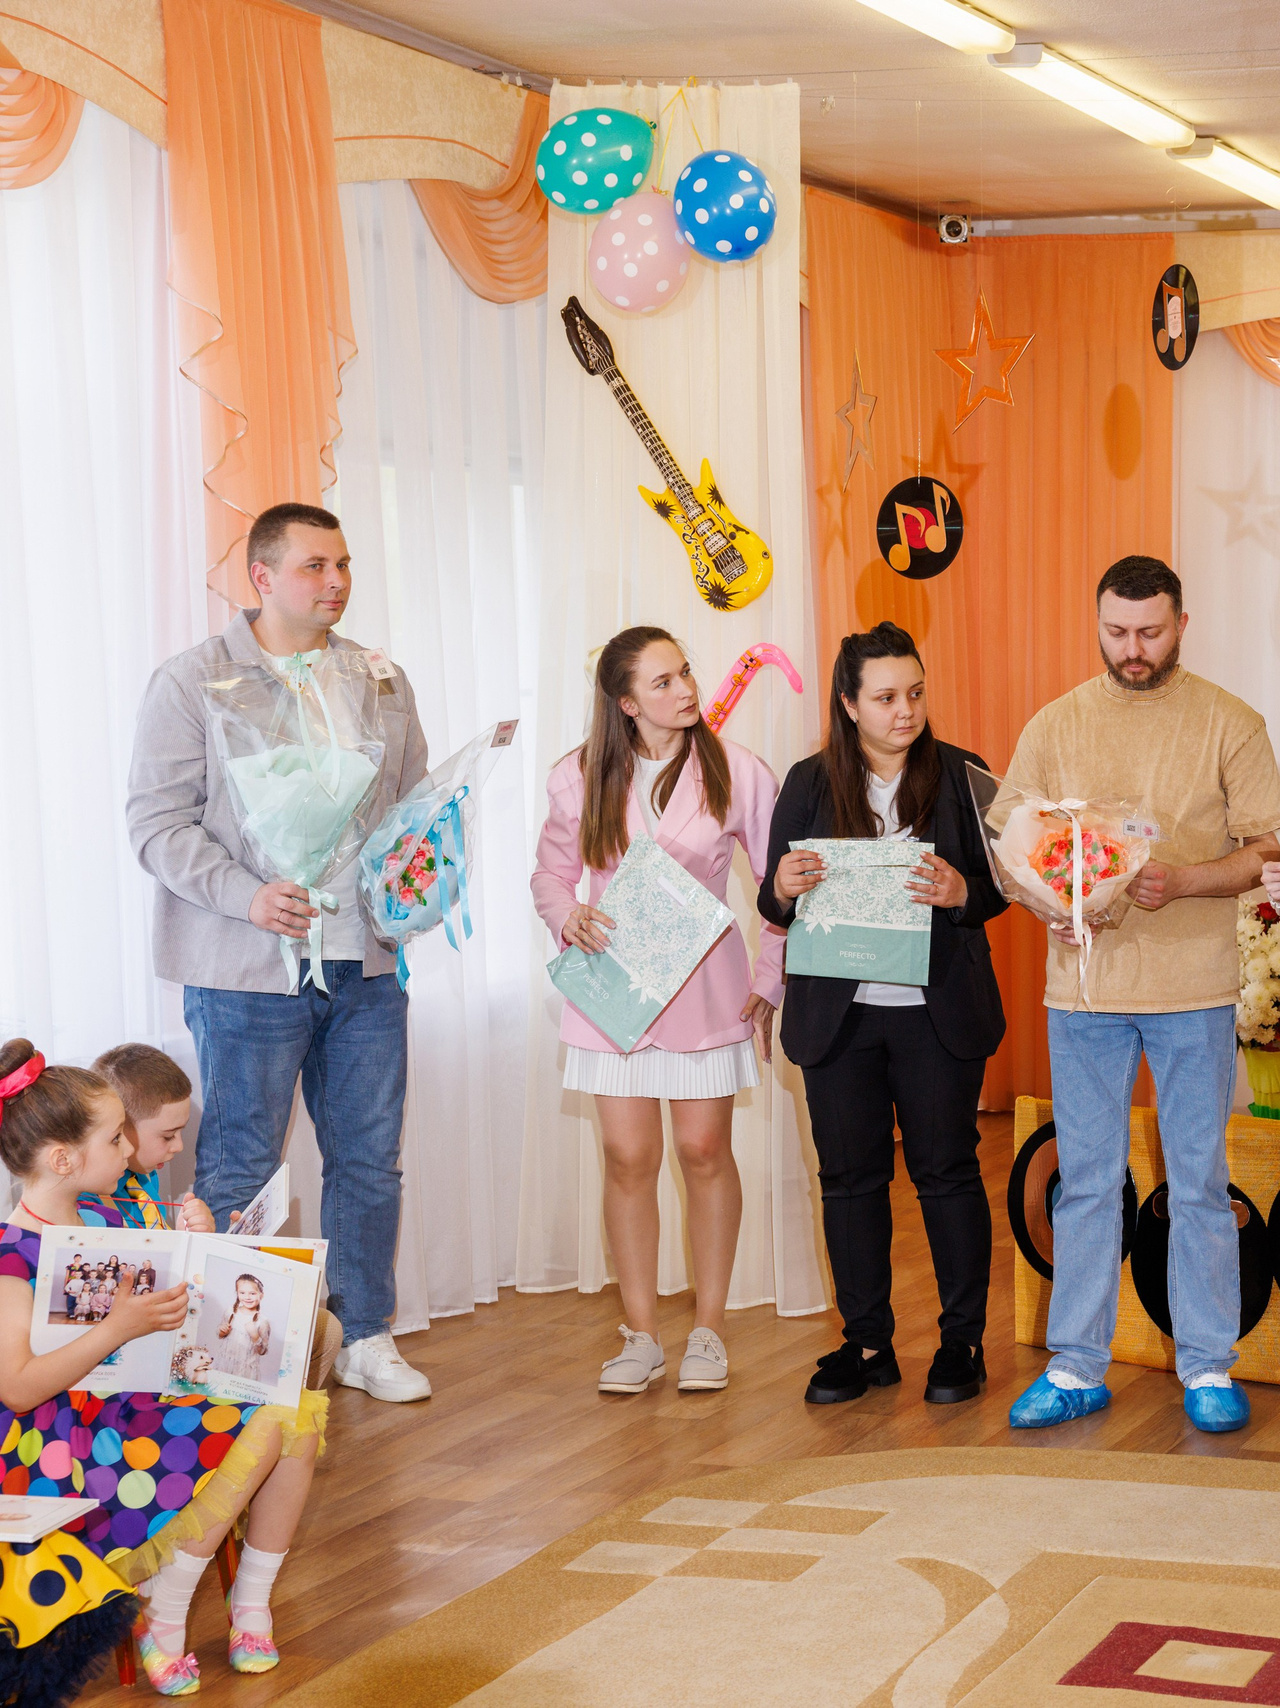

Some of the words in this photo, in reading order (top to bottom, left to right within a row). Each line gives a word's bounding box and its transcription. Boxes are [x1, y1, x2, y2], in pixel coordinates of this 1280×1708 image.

[673, 513, 698, 545] Roll
[839, 950, 877, 961] PERFECTO
[583, 972, 610, 1000] PERFECTO
